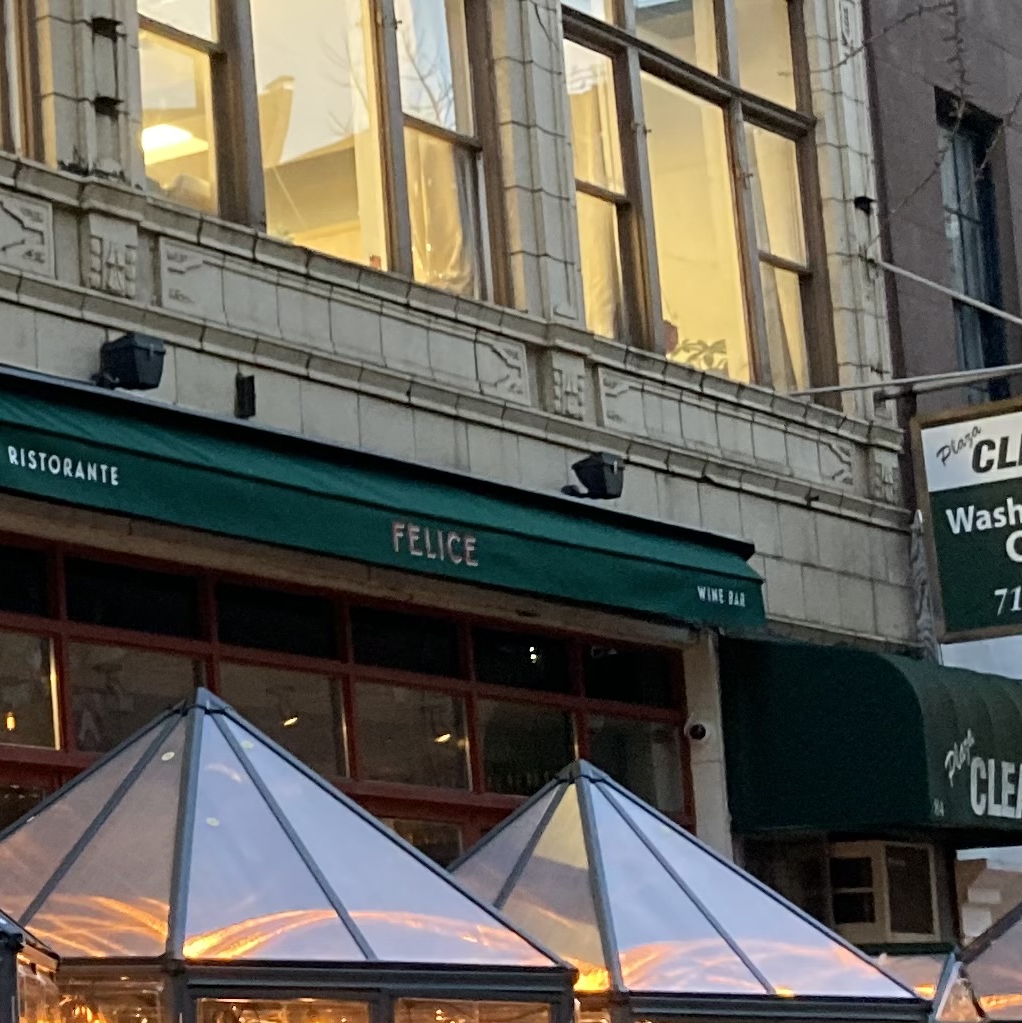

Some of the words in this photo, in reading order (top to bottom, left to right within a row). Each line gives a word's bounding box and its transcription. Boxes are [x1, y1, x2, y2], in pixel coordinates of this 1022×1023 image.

[7, 445, 120, 486] RISTORANTE
[935, 425, 982, 466] Plaza
[971, 433, 1022, 473] CL
[391, 521, 479, 567] FELICE
[697, 585, 724, 604] WINE
[728, 590, 746, 607] BAR
